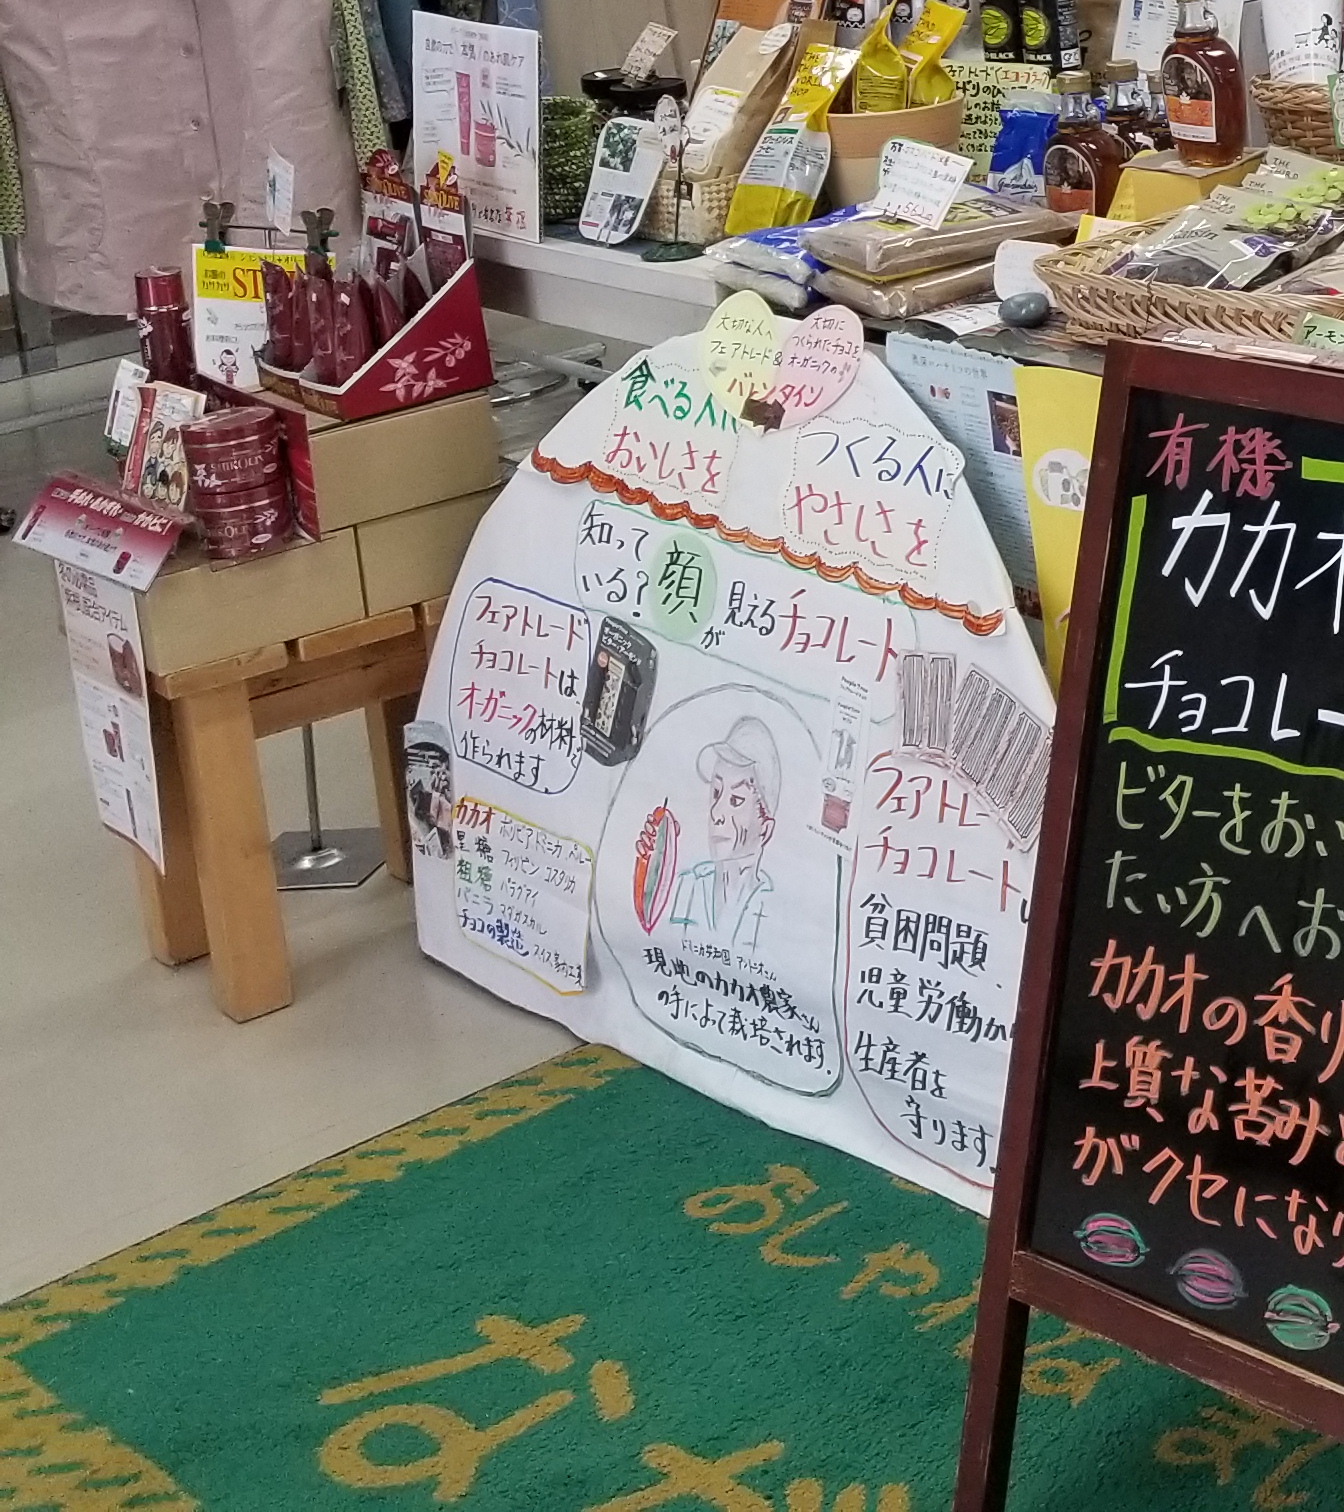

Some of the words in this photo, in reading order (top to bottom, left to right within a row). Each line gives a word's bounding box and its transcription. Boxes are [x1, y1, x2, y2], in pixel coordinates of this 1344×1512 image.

[811, 314, 846, 332] 大切に
[727, 371, 825, 409] バレンタイン
[604, 424, 723, 496] おいしさを
[800, 430, 954, 501] つくる人に
[1148, 413, 1293, 499] 有機
[580, 508, 650, 563] 知って
[786, 483, 929, 568] やさしさを
[475, 594, 590, 652] フェアトレード
[455, 797, 496, 834] カカオ
[457, 887, 494, 916] バニラ
[853, 1032, 949, 1100] 生産者を
[900, 1095, 999, 1176] 守ります。
